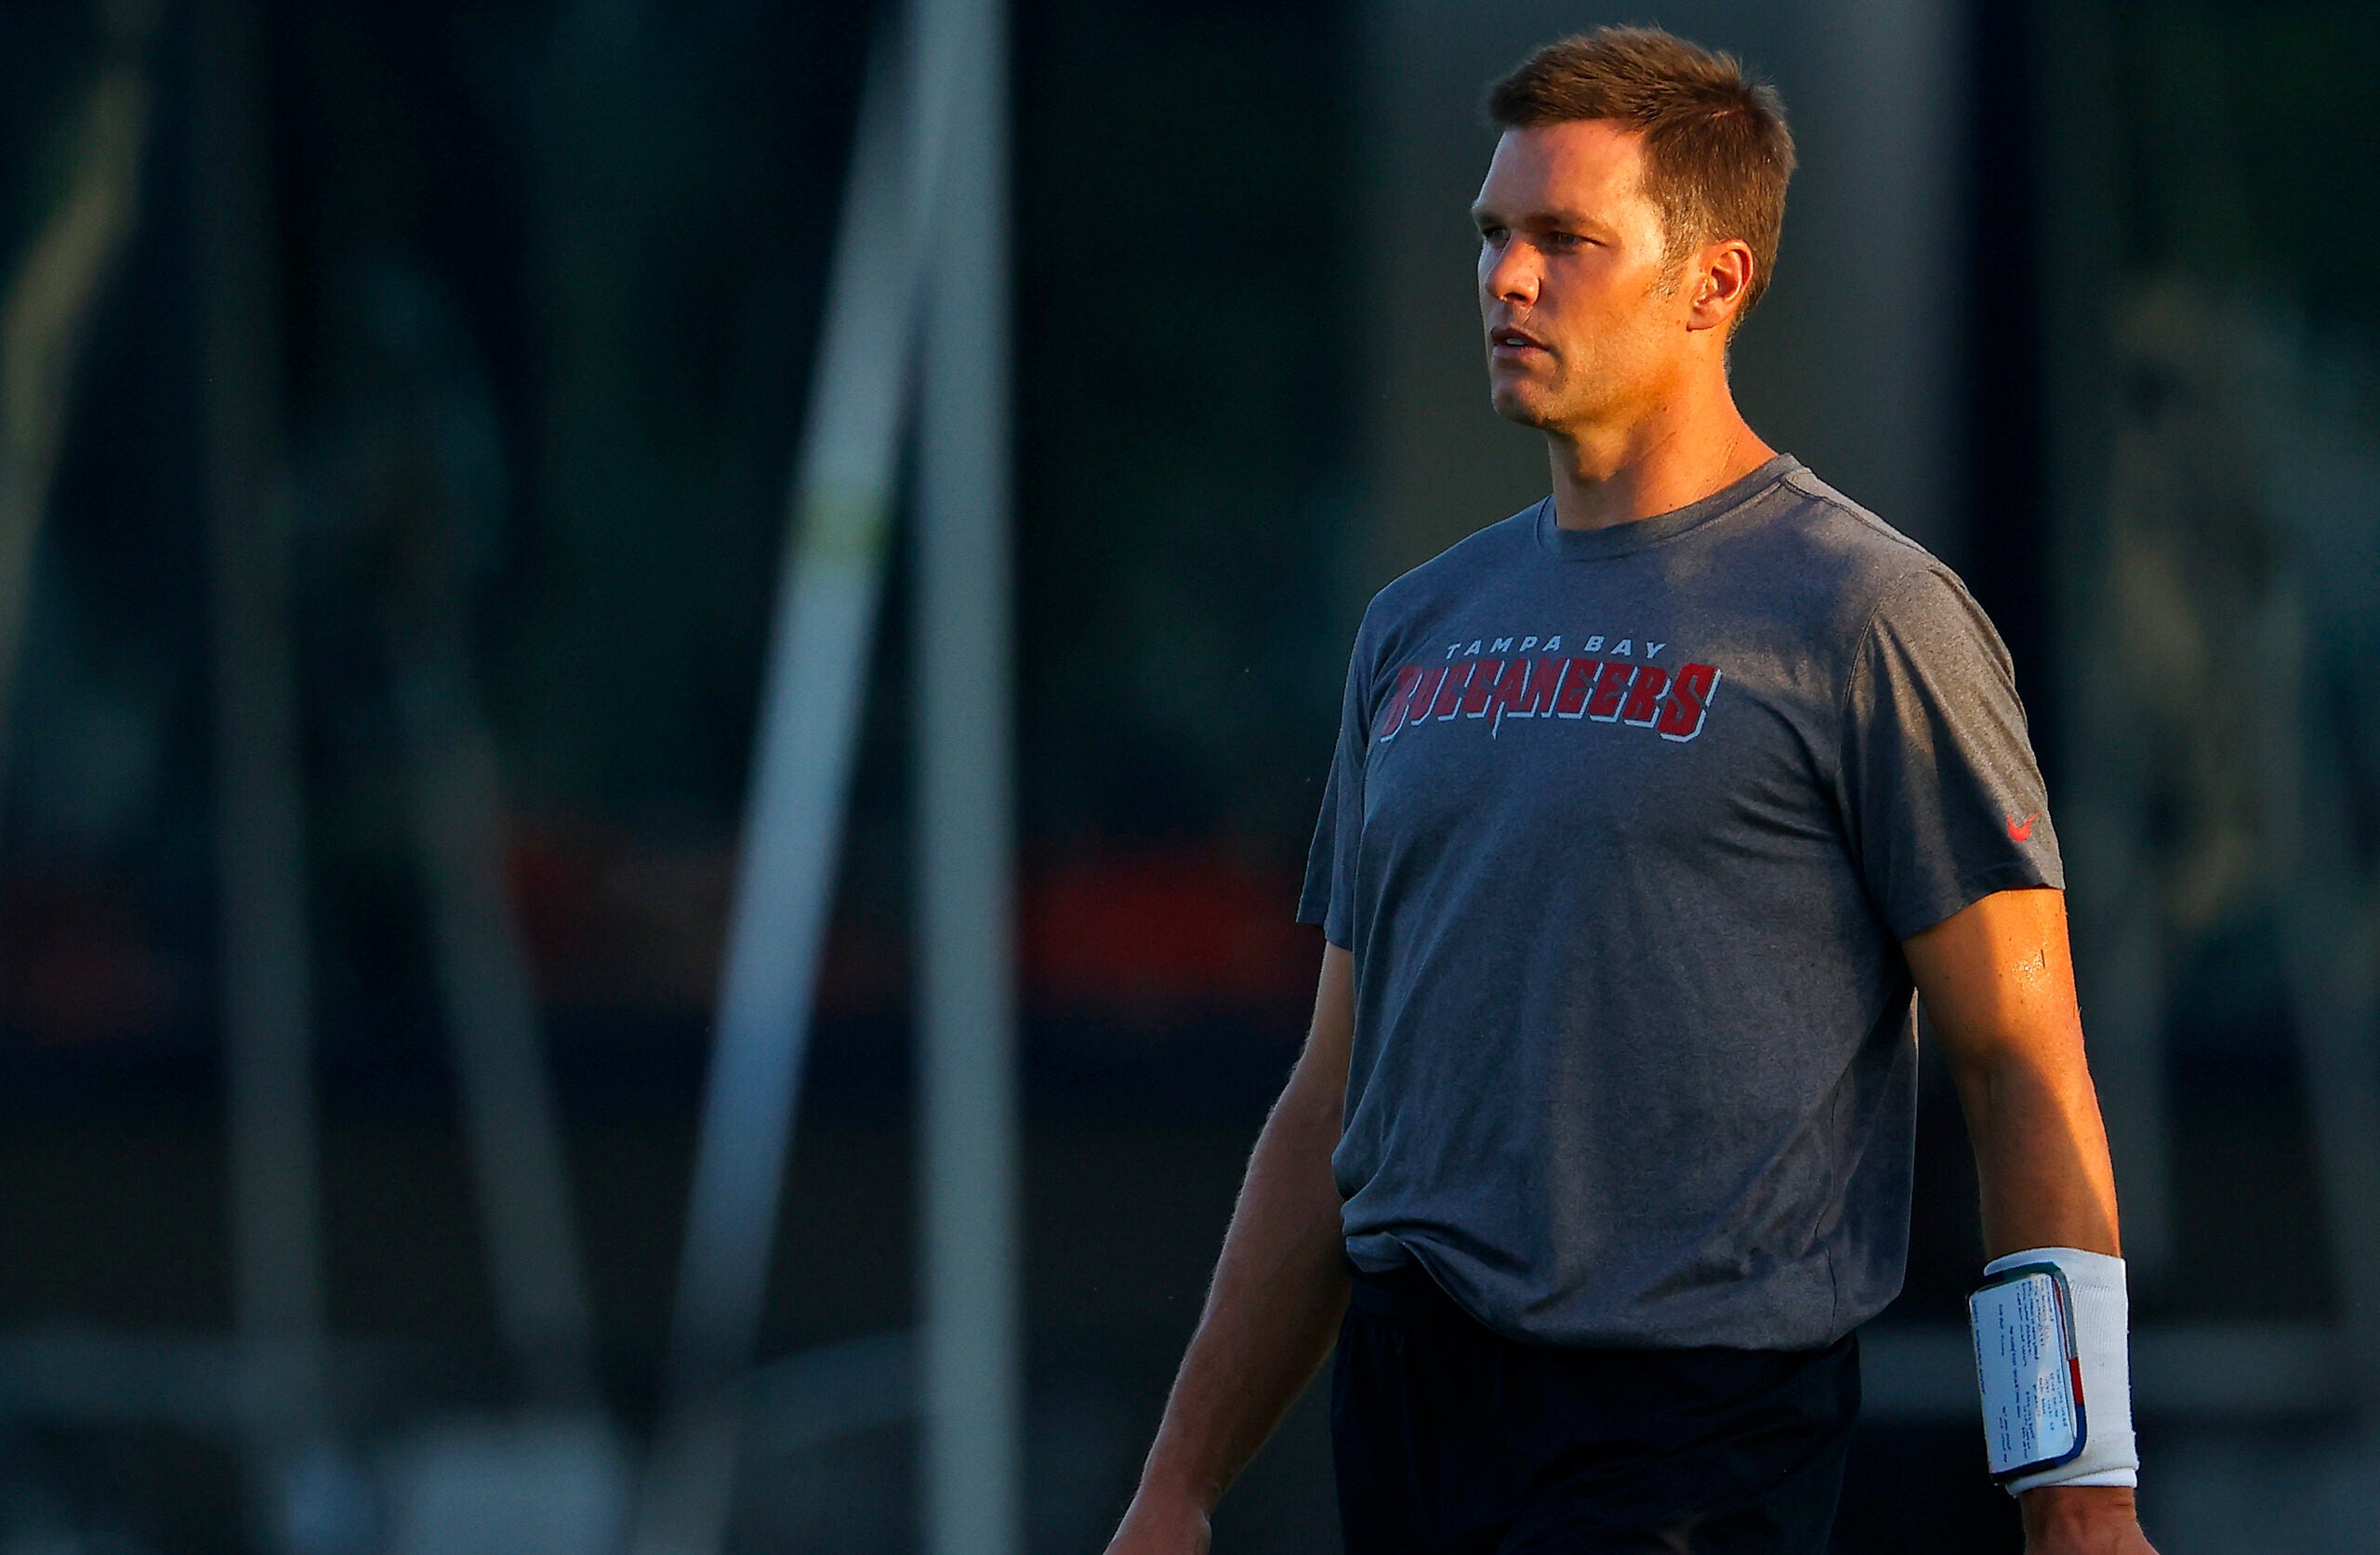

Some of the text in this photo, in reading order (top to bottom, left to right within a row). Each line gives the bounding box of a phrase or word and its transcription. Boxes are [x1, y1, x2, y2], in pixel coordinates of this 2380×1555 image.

[1446, 636, 1667, 660] TAMPA BAY
[1381, 659, 1723, 743] BUCCANEERS
